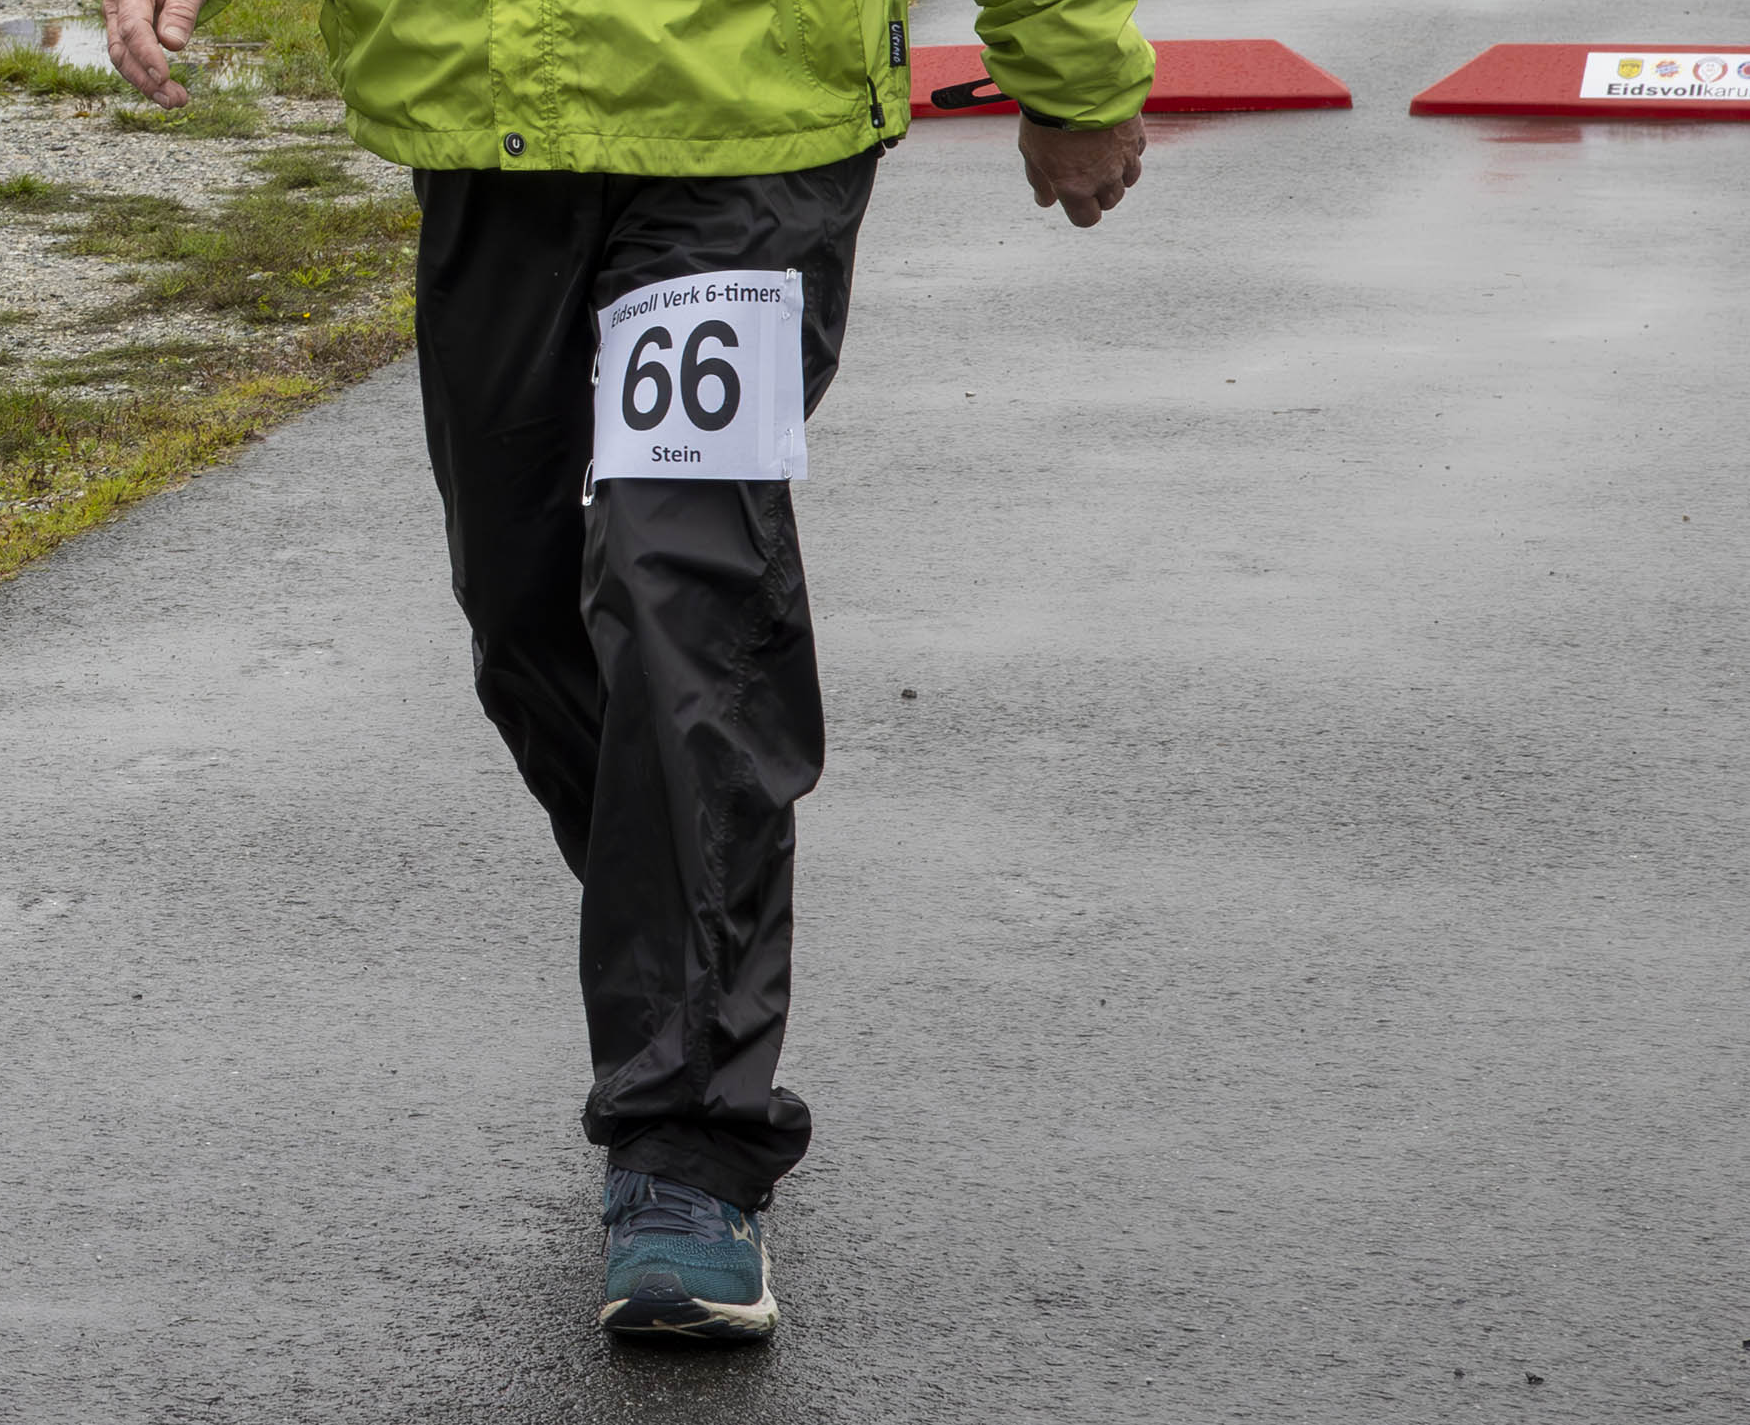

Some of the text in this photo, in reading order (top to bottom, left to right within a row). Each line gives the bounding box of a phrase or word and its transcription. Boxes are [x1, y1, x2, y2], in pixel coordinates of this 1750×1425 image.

[1607, 83, 1750, 97] Eidsvollkaru
[611, 283, 781, 328] Eidsvoll Verk 6-timers
[621, 319, 741, 432] 66
[651, 445, 700, 463] Stein
